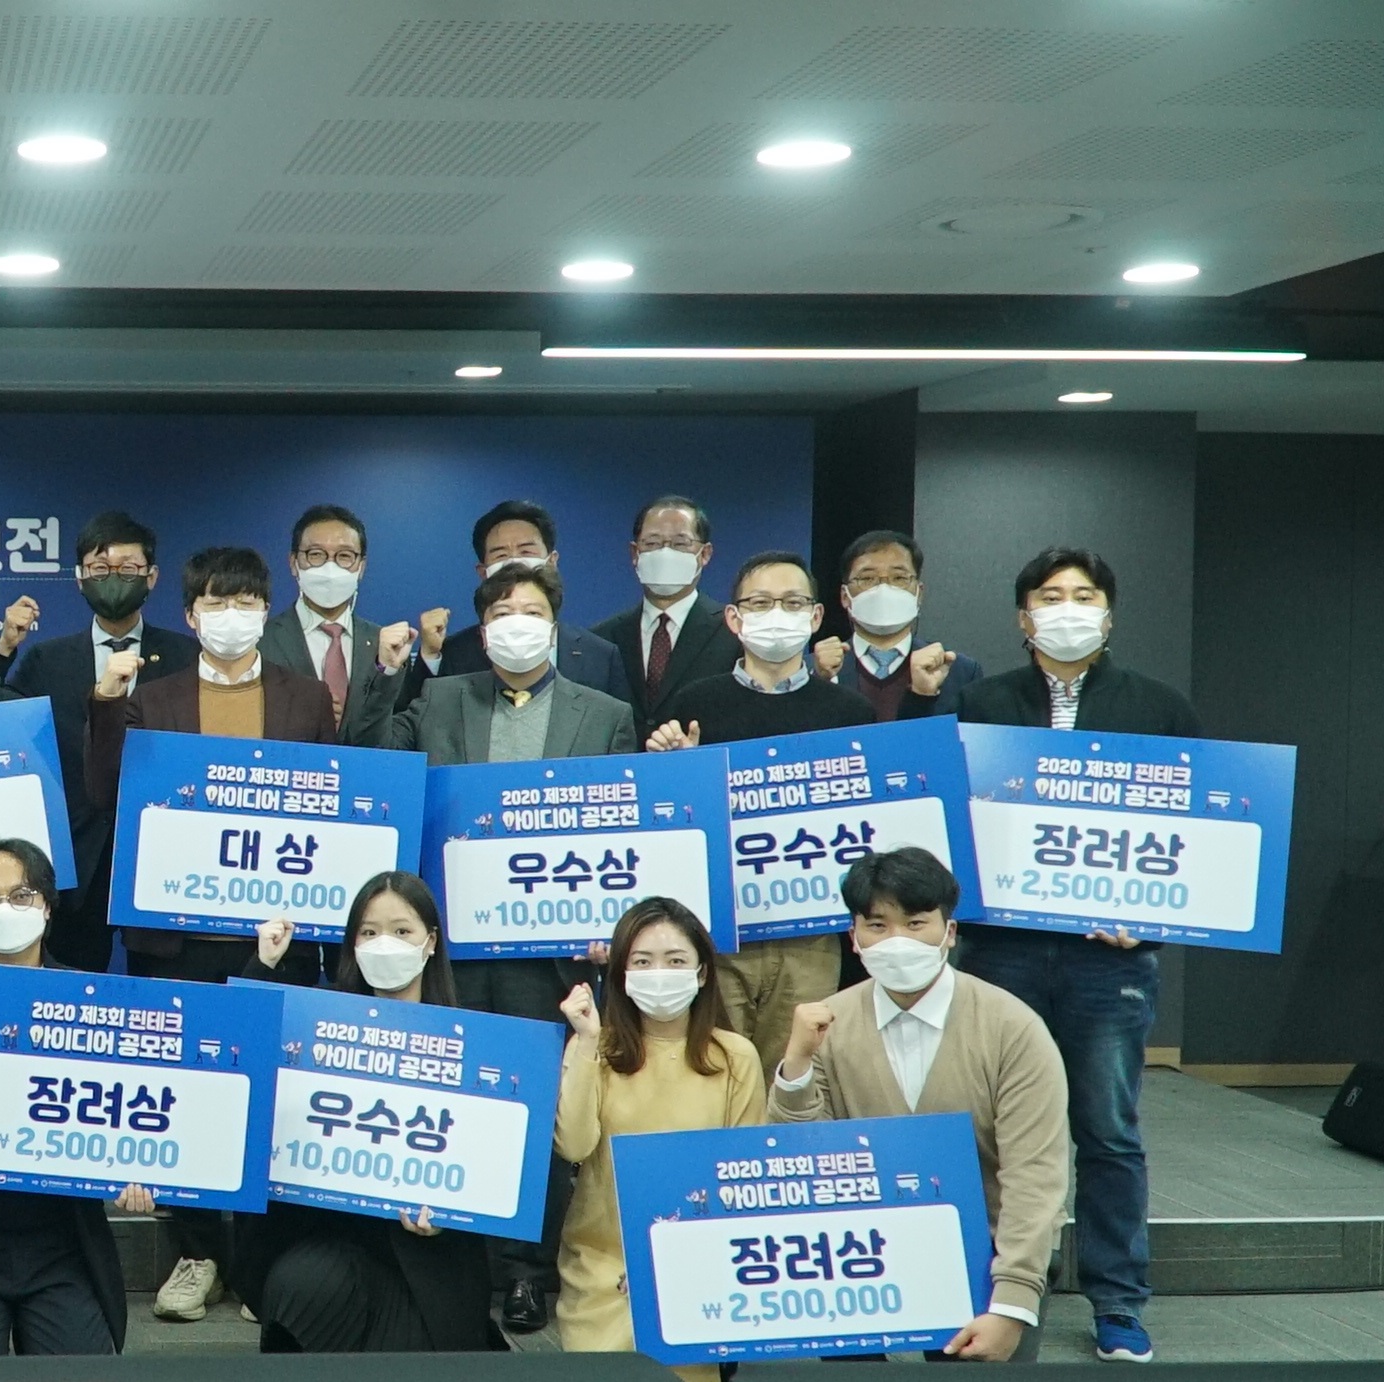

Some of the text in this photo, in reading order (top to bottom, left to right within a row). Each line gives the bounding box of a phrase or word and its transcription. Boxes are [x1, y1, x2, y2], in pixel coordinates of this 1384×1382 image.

[207, 765, 339, 792] 2020 제3회 핀테크
[767, 761, 811, 782] 제3회
[813, 756, 867, 776] 핀테크
[1038, 757, 1191, 785] 2020 제3회 핀테크
[205, 786, 339, 816] 아이디어 공모전
[502, 783, 638, 806] 2020 제3회 핀테크
[809, 777, 872, 804] 공모전
[1035, 778, 1191, 811] 아이디어 공모전
[502, 804, 640, 832] 아이디어 공모전
[736, 821, 875, 874] 우수상
[1034, 823, 1184, 876] 장려상
[508, 848, 640, 893] 우수상
[32, 1001, 183, 1033] 2020 제3회 핀테크
[30, 1024, 182, 1061] 아이디어 공모전
[316, 1021, 464, 1060] 2020 제3회 핀테크
[313, 1043, 463, 1086] 아이디어 공모전
[28, 1076, 176, 1132] 장려상
[307, 1090, 454, 1153] 우수상
[717, 1152, 876, 1180] 2020 제3회 핀테크
[719, 1176, 881, 1211] 아이디어 공모전
[730, 1229, 887, 1285] 장려상
